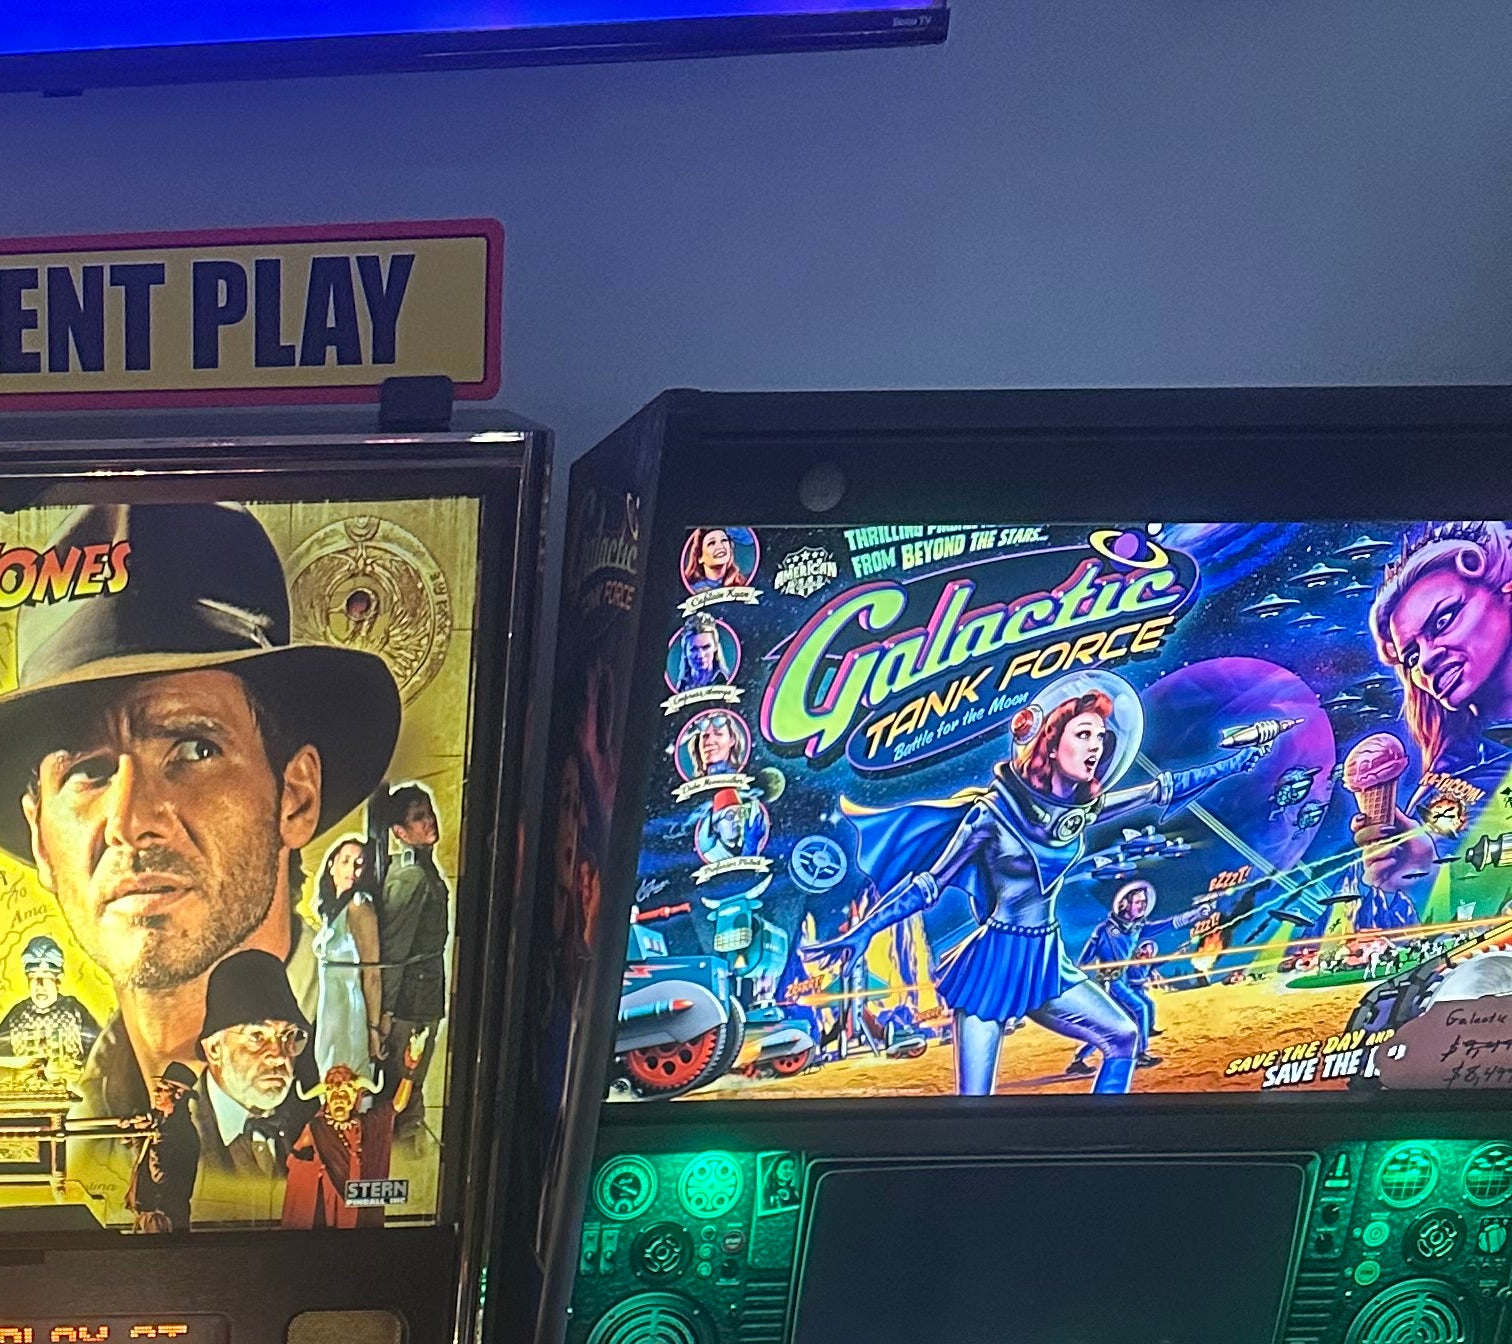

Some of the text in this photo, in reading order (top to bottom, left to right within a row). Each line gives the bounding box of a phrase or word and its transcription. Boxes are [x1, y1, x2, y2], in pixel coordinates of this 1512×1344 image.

[191, 252, 416, 371] PLAY
[851, 546, 896, 579] FROM
[901, 534, 966, 571] BEYOND
[969, 530, 996, 552] THE
[761, 558, 1187, 759] Galactic
[864, 614, 1175, 760] TANK FORCE
[893, 692, 1029, 762] Battle for the Moon
[1226, 1051, 1279, 1075] SAVE
[1280, 1042, 1324, 1063] THE
[1326, 1030, 1365, 1052] DAY
[1262, 1051, 1361, 1088] SAVE THE
[346, 1179, 408, 1199] STERN
